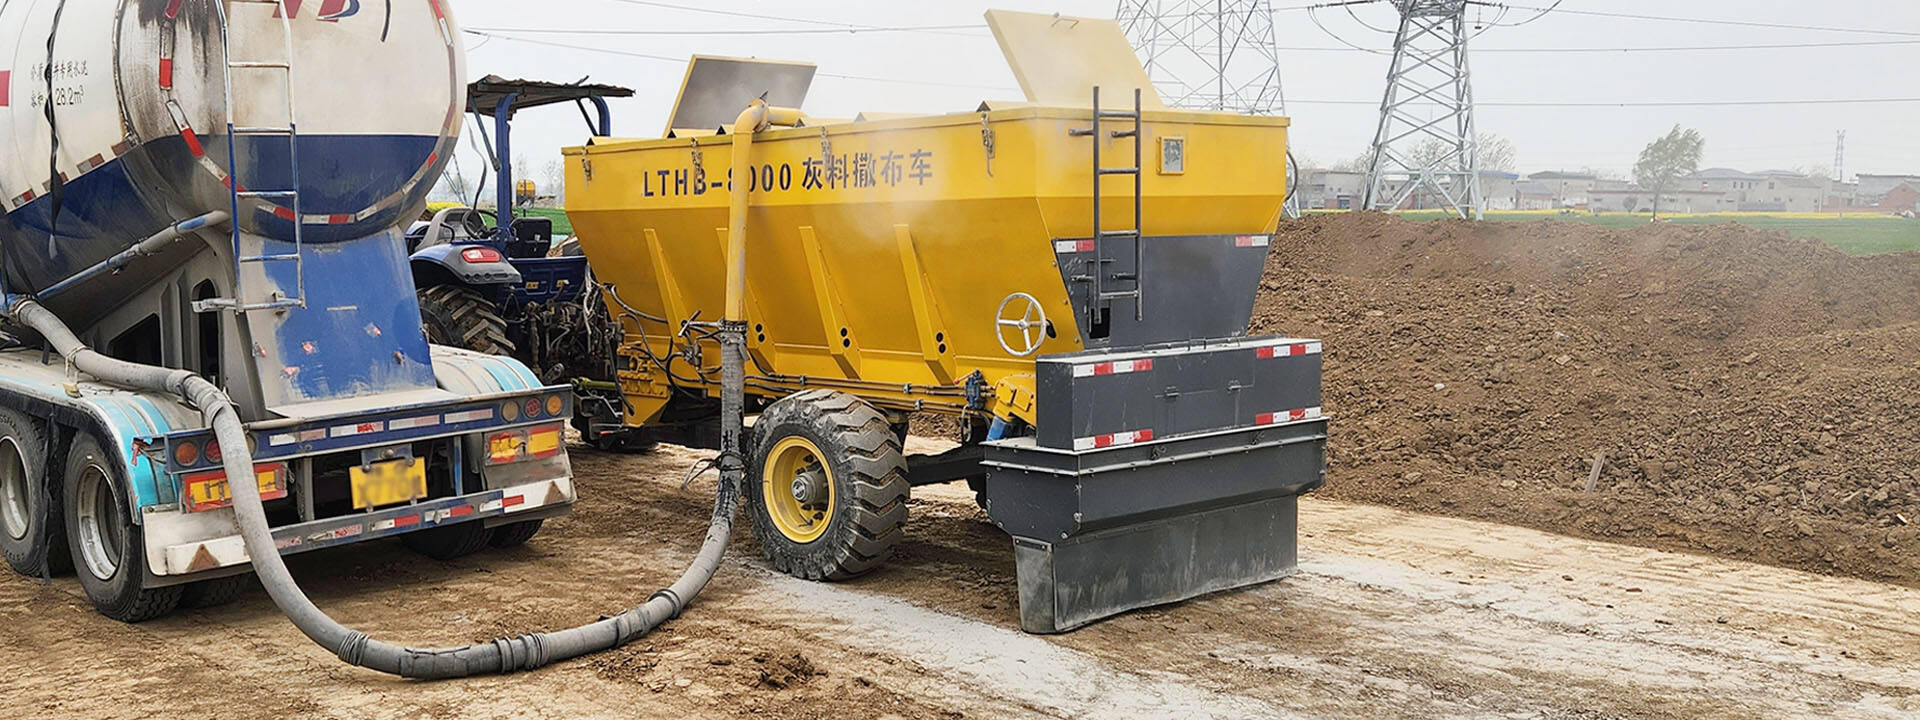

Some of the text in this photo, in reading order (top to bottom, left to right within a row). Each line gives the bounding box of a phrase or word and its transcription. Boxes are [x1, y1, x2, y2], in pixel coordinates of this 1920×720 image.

[801, 148, 933, 190] 灰料撒布车
